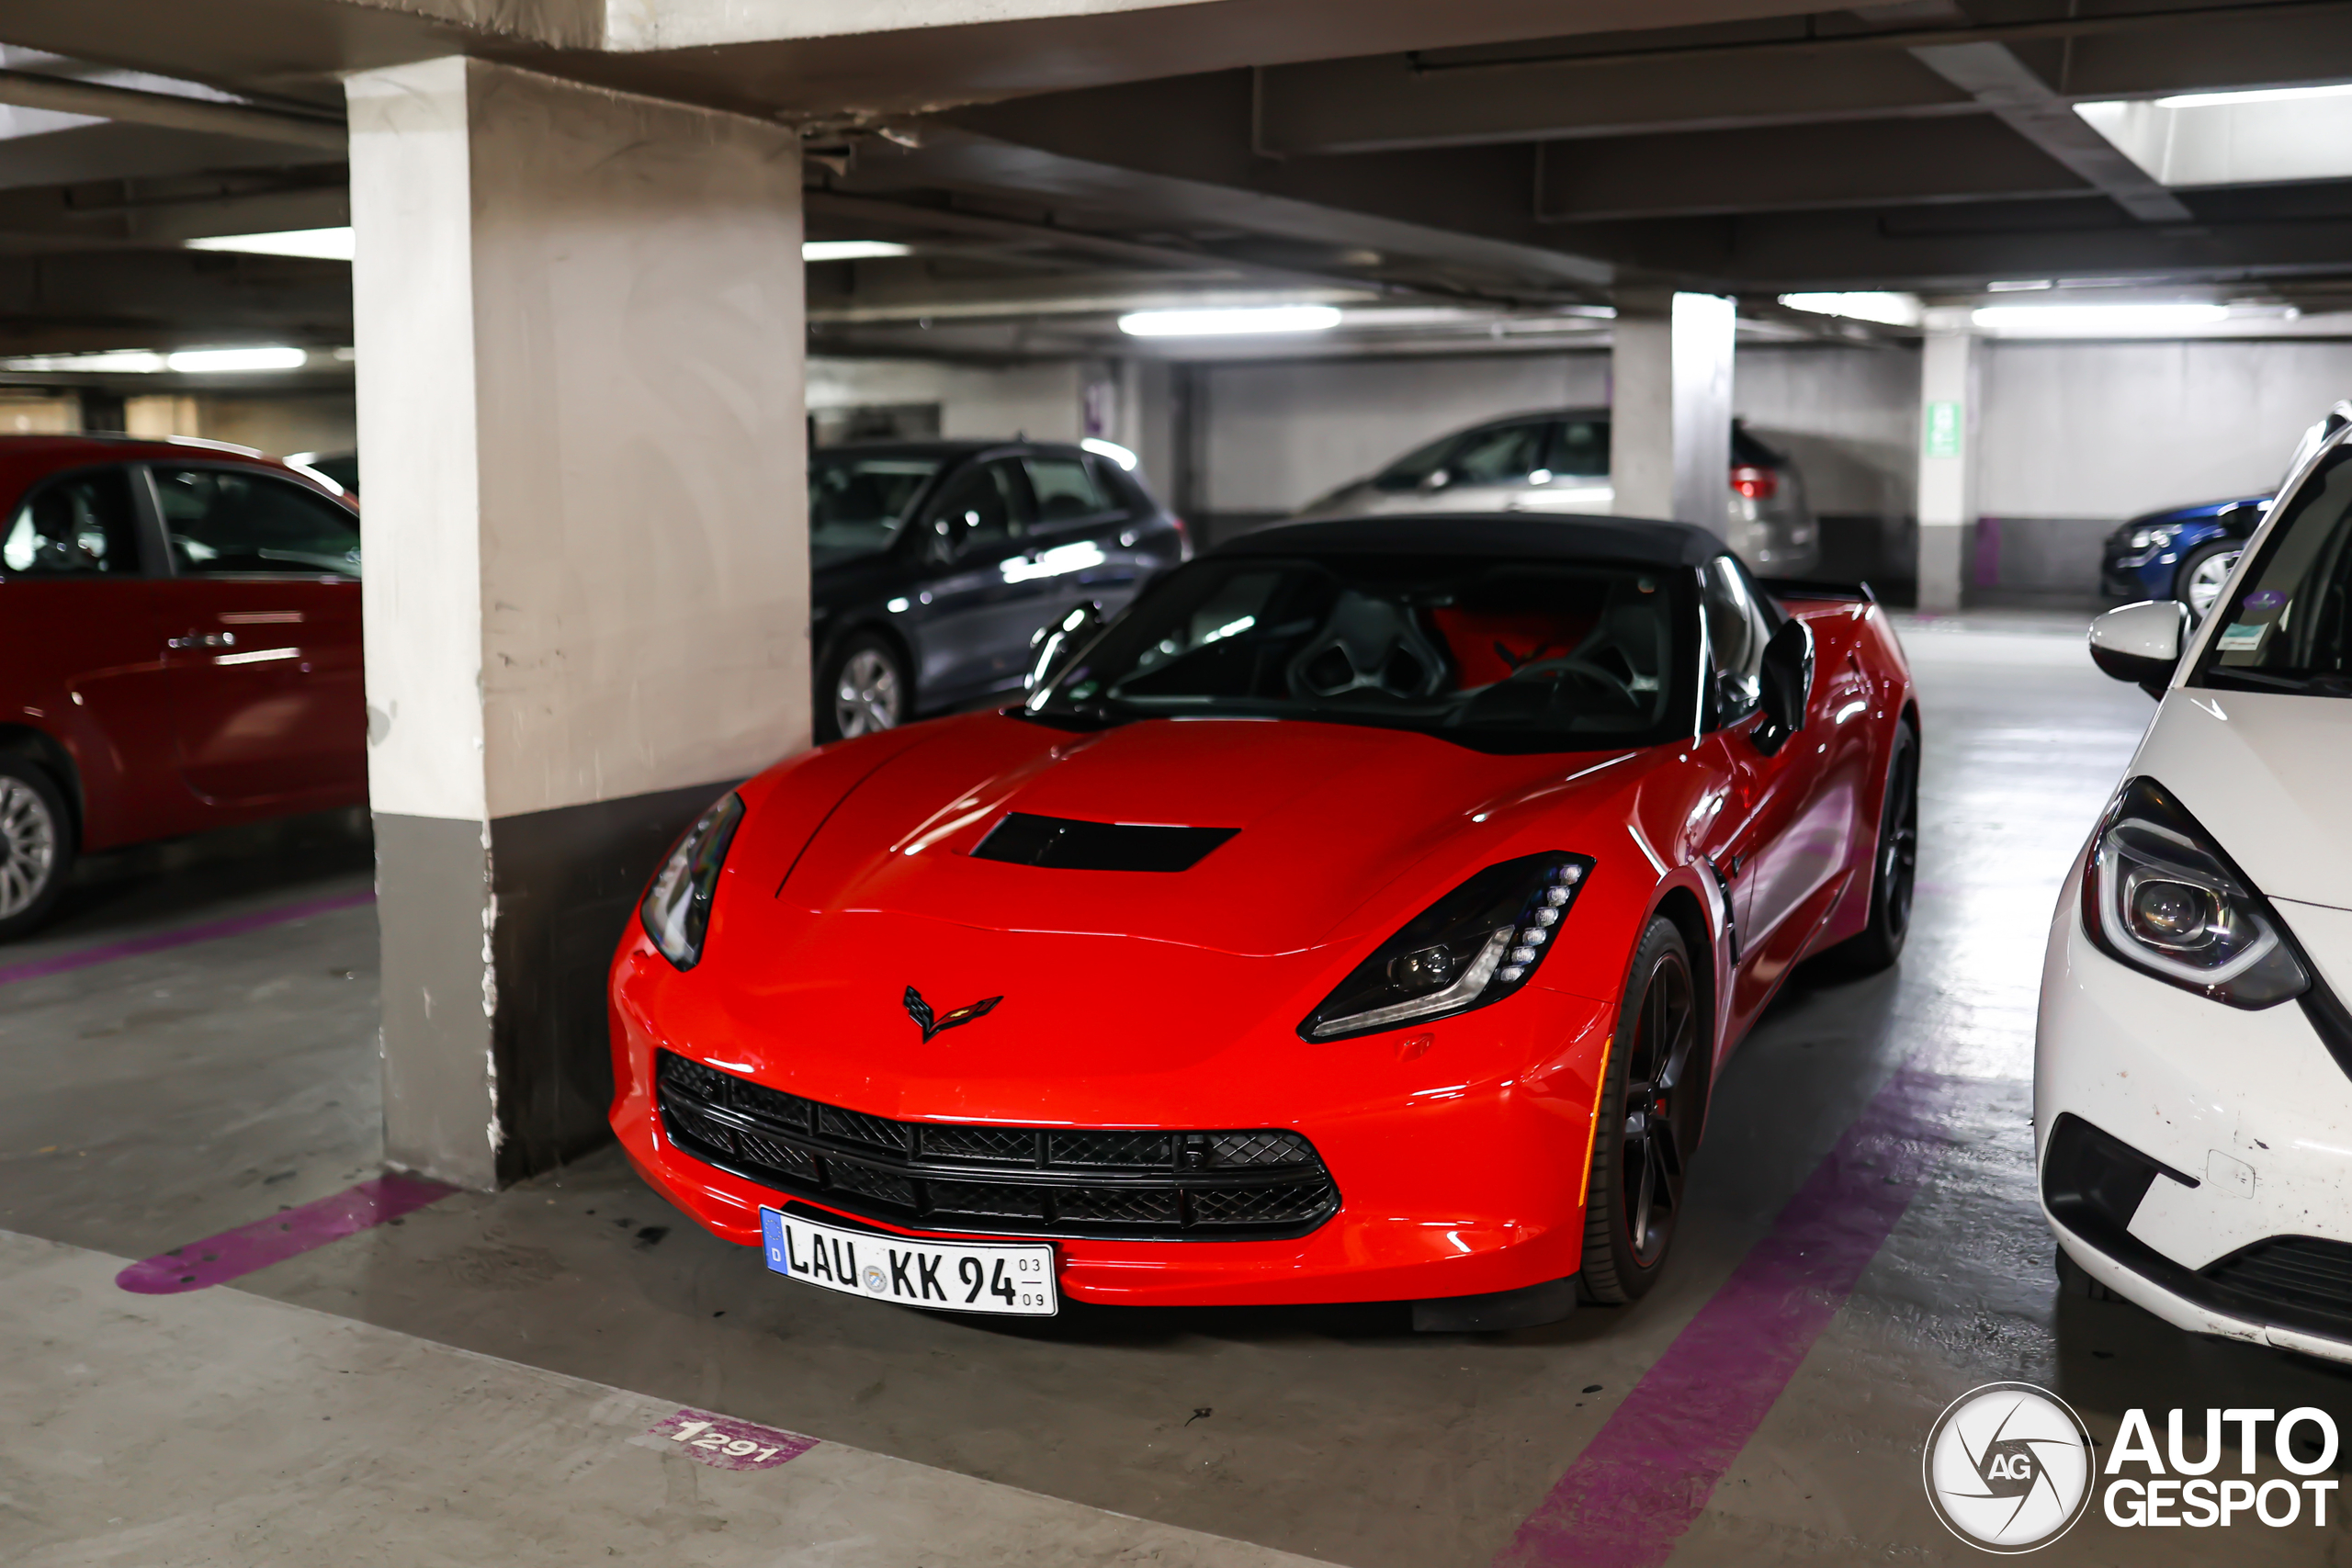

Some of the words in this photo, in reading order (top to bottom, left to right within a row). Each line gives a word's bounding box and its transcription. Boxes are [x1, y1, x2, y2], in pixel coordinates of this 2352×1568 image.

[772, 1247, 781, 1263] D
[786, 1224, 858, 1288] LAU
[888, 1249, 947, 1302] KK
[958, 1257, 1016, 1306] 94
[1019, 1258, 1041, 1272] 03
[1023, 1293, 1044, 1306] 09
[671, 1421, 780, 1462] 1291
